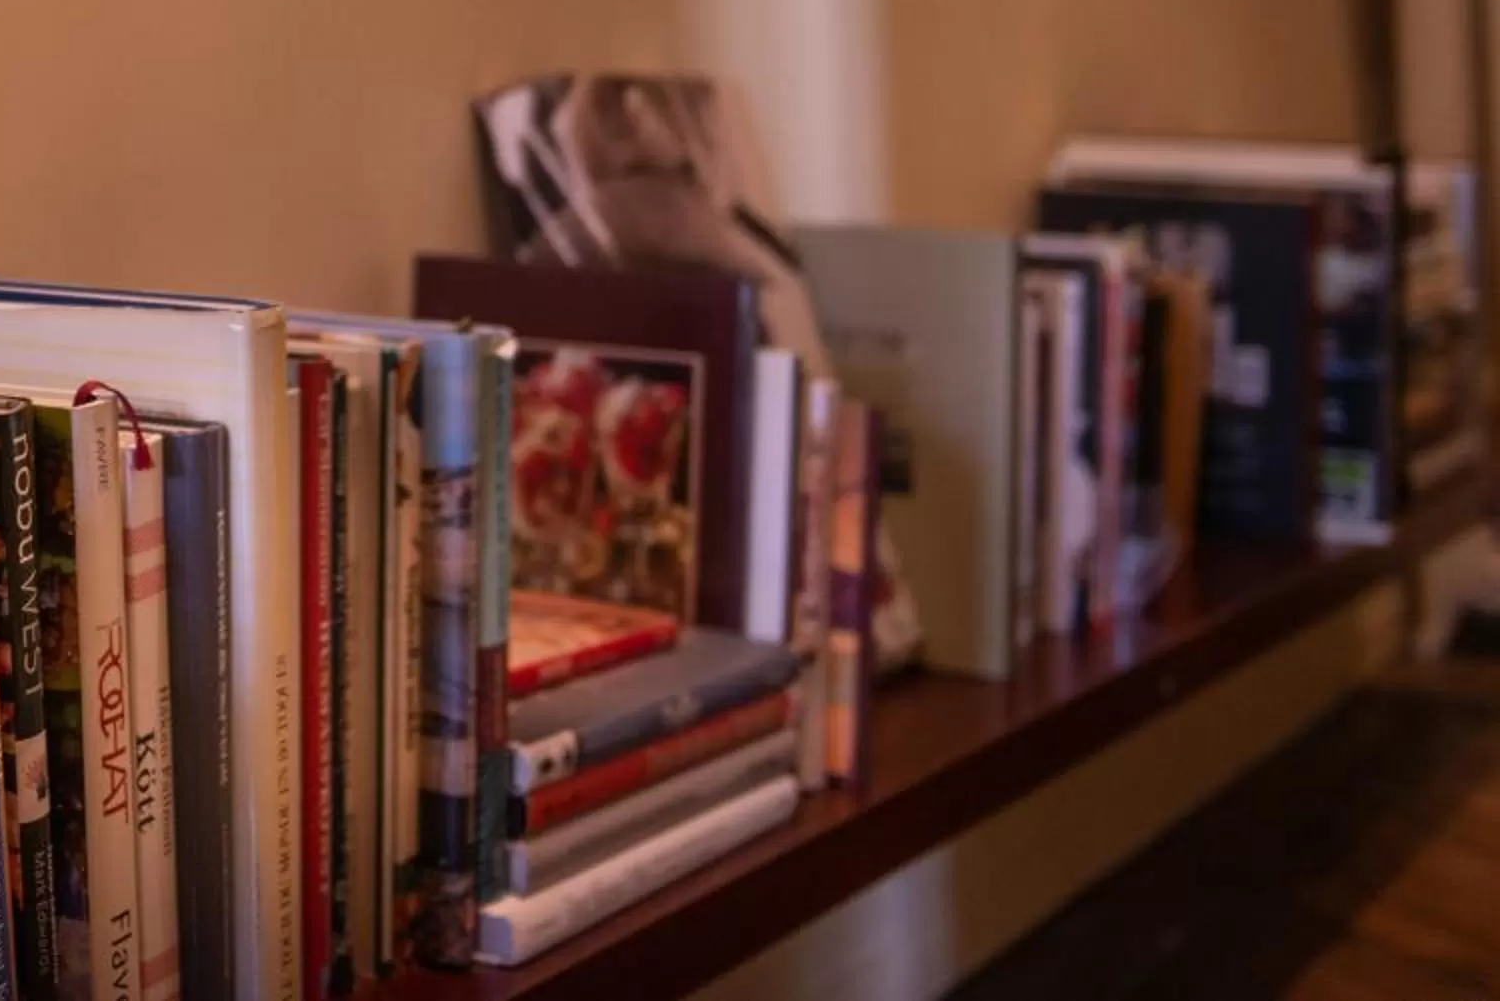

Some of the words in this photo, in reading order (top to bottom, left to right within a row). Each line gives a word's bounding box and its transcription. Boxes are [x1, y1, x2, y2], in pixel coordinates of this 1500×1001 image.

[13, 433, 35, 564] nobu
[20, 570, 44, 696] WEST
[135, 730, 157, 835] Kött
